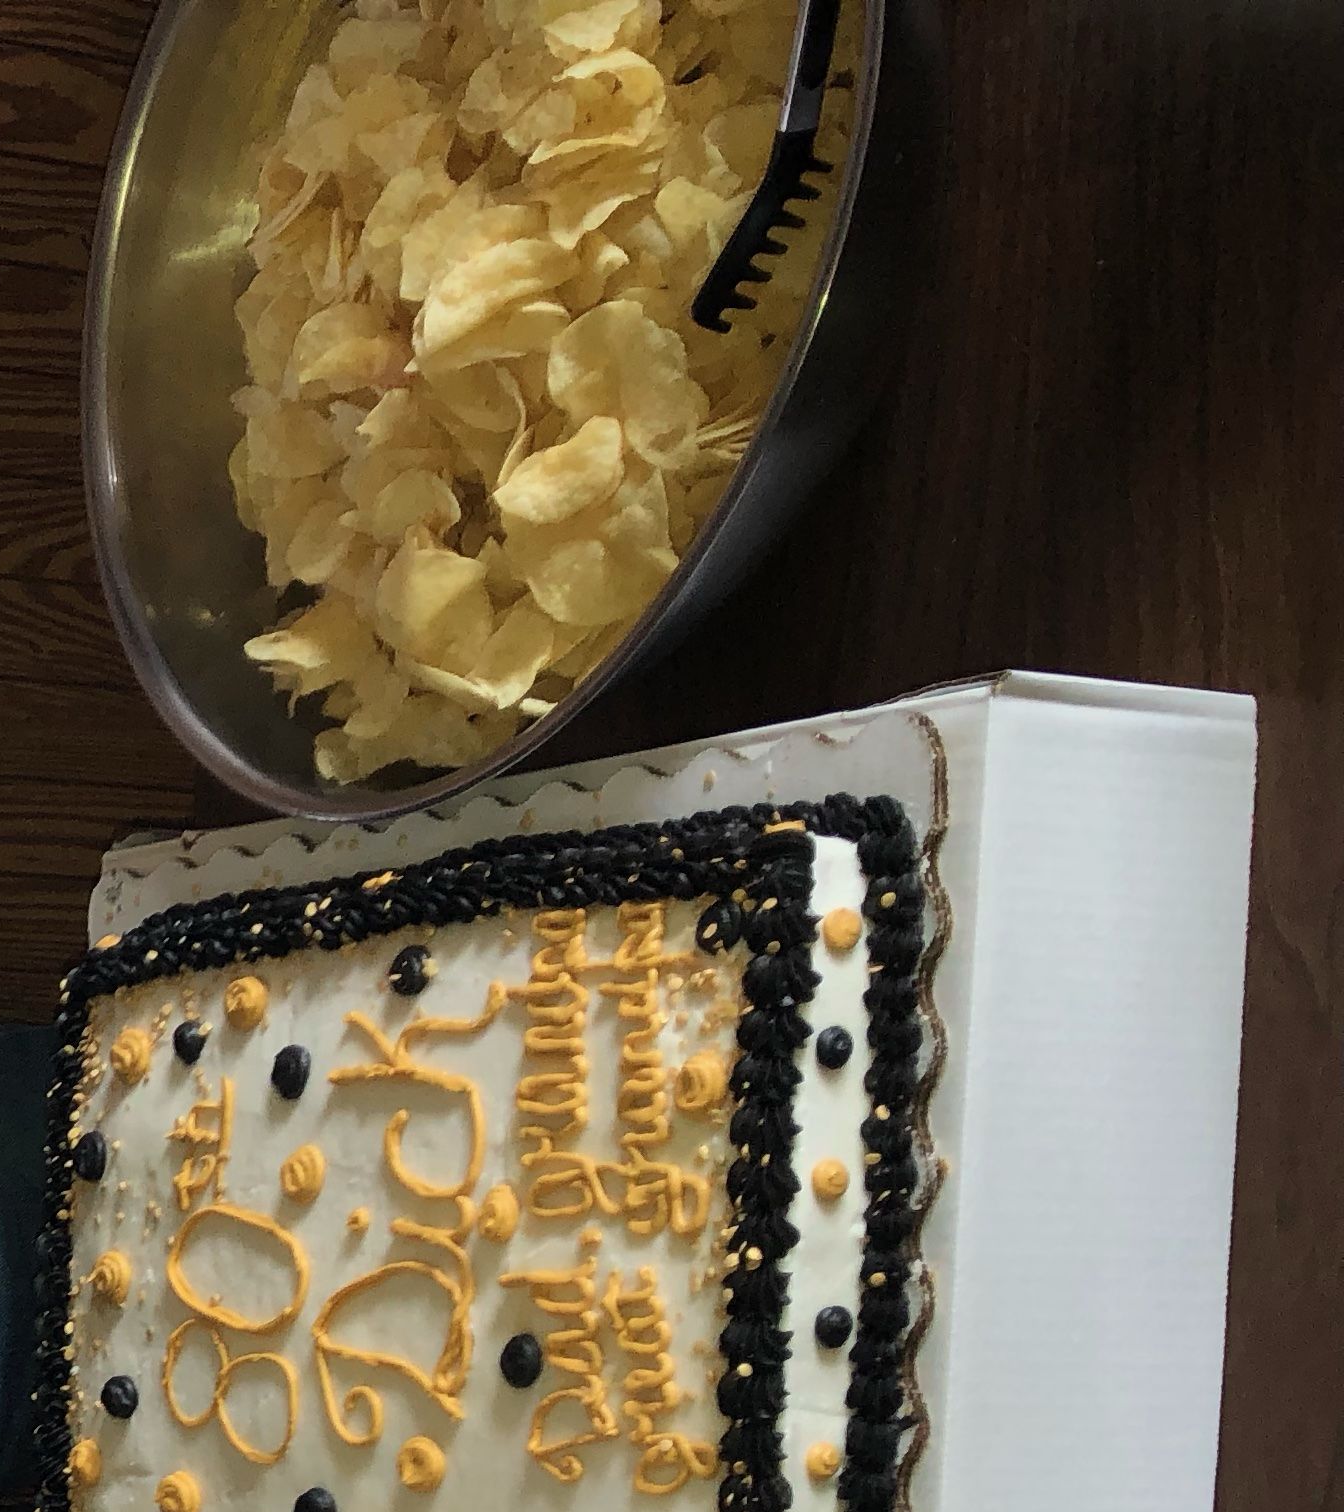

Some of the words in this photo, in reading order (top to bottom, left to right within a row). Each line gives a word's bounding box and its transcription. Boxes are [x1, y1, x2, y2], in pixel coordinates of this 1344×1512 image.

[159, 1074, 308, 1464] 80th
[312, 980, 506, 1449] Dick
[603, 1265, 714, 1495] great
